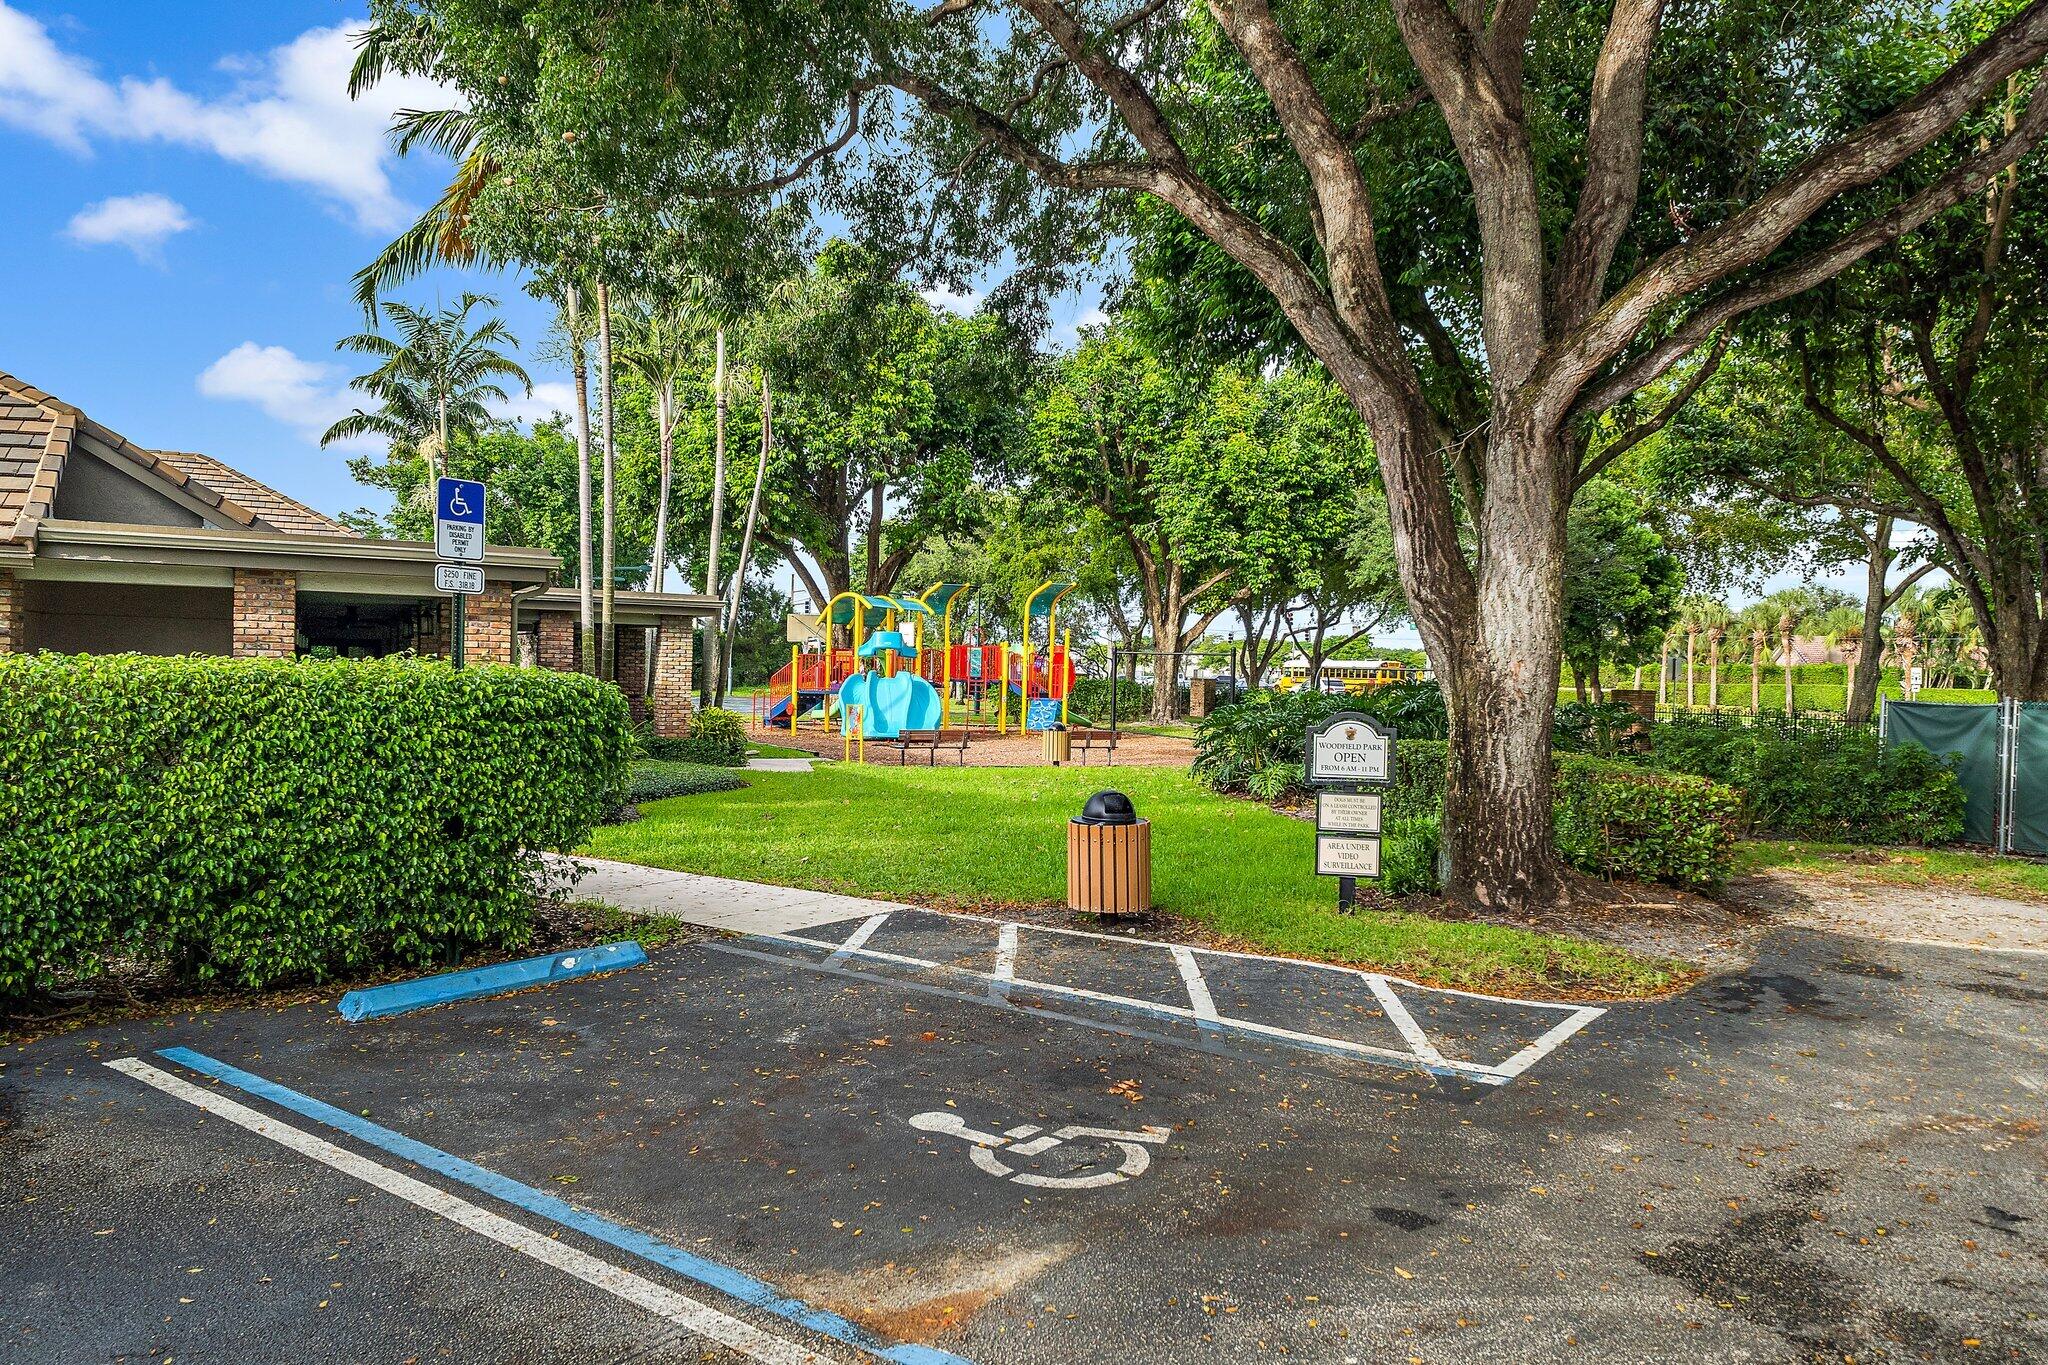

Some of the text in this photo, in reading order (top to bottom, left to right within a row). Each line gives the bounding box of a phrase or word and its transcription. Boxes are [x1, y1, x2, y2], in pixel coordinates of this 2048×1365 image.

[443, 569, 477, 579] $250 FINE
[1334, 752, 1366, 762] OPEN
[1324, 862, 1372, 870] SURVEILLANCE
